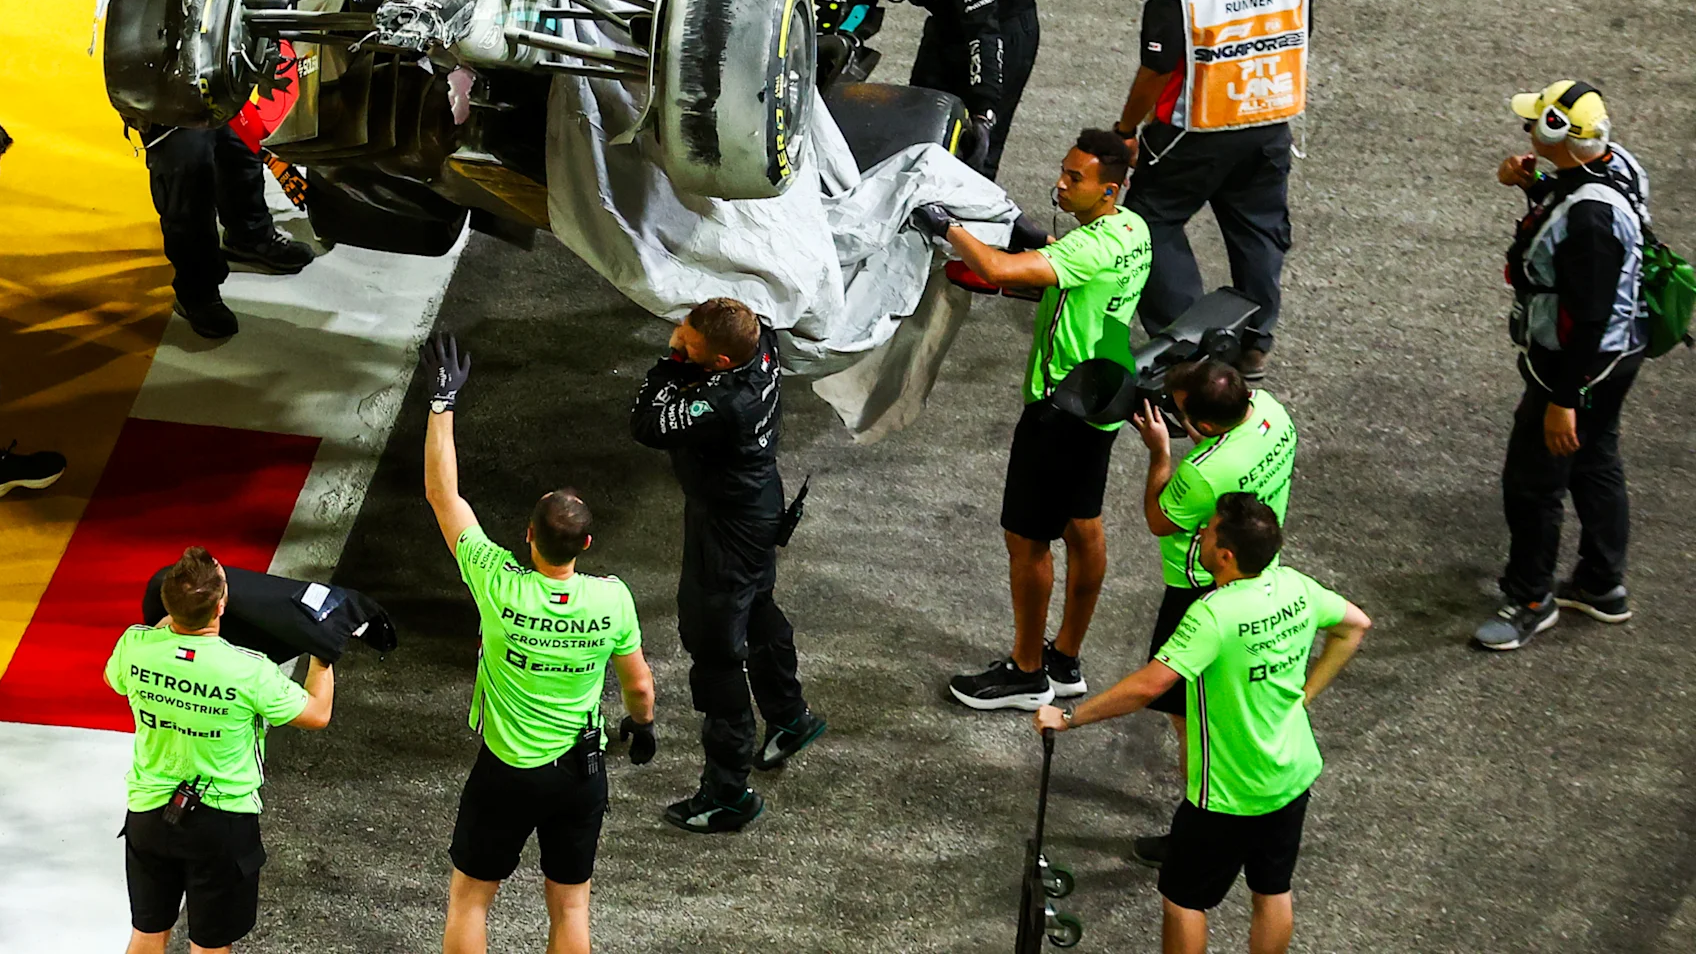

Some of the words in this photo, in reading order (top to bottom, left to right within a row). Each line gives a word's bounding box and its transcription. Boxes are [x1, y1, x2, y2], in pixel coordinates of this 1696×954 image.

[1236, 56, 1281, 80] PIT
[1227, 72, 1293, 100] LANE
[1238, 424, 1295, 489] PETRONA
[501, 607, 611, 634] PETRONAS
[511, 633, 606, 648] CROWDSTRIKE
[530, 662, 596, 673] Einhell
[131, 664, 236, 701] PETRONAS
[140, 690, 229, 716] CROWDSTRIKE
[160, 720, 221, 738] Einhell
